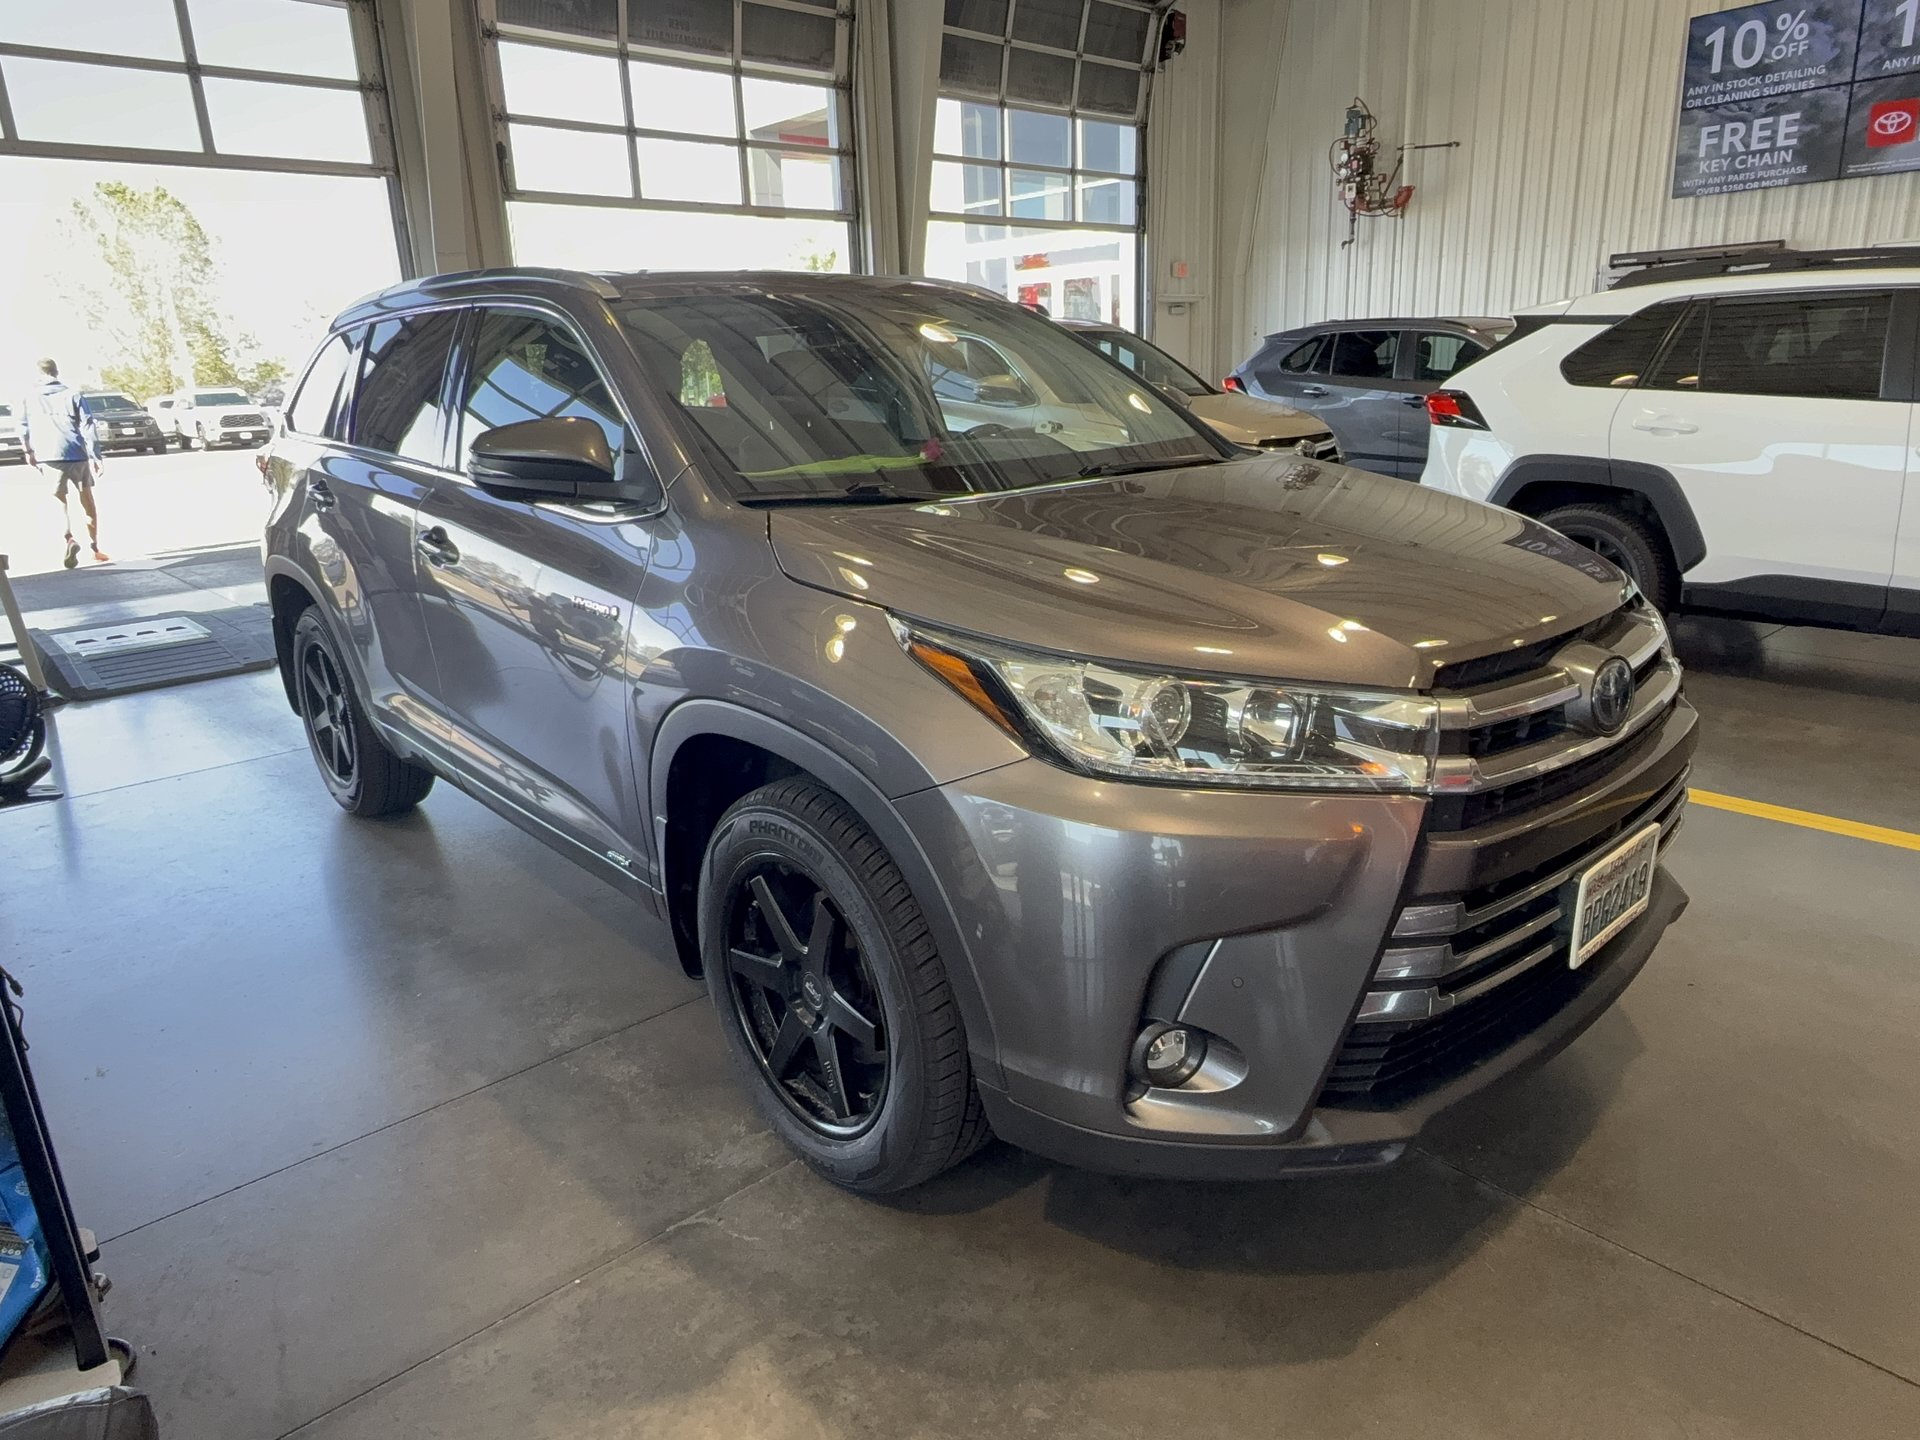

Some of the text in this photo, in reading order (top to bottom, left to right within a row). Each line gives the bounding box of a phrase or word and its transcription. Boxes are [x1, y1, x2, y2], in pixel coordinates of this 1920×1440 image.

[1771, 40, 1809, 60] OFF
[1882, 56, 1910, 71] ANY
[1687, 64, 1826, 97] ANY IN STOCK DETAILING
[1685, 79, 1816, 109] OR CLEANING SUPPLIES
[1699, 112, 1801, 158] FREE
[1699, 149, 1793, 174] KEY CHAIN
[1682, 164, 1808, 188] WITH ANY PARTS PURCHASE
[1696, 177, 1790, 196] OVER $250 OR MORE
